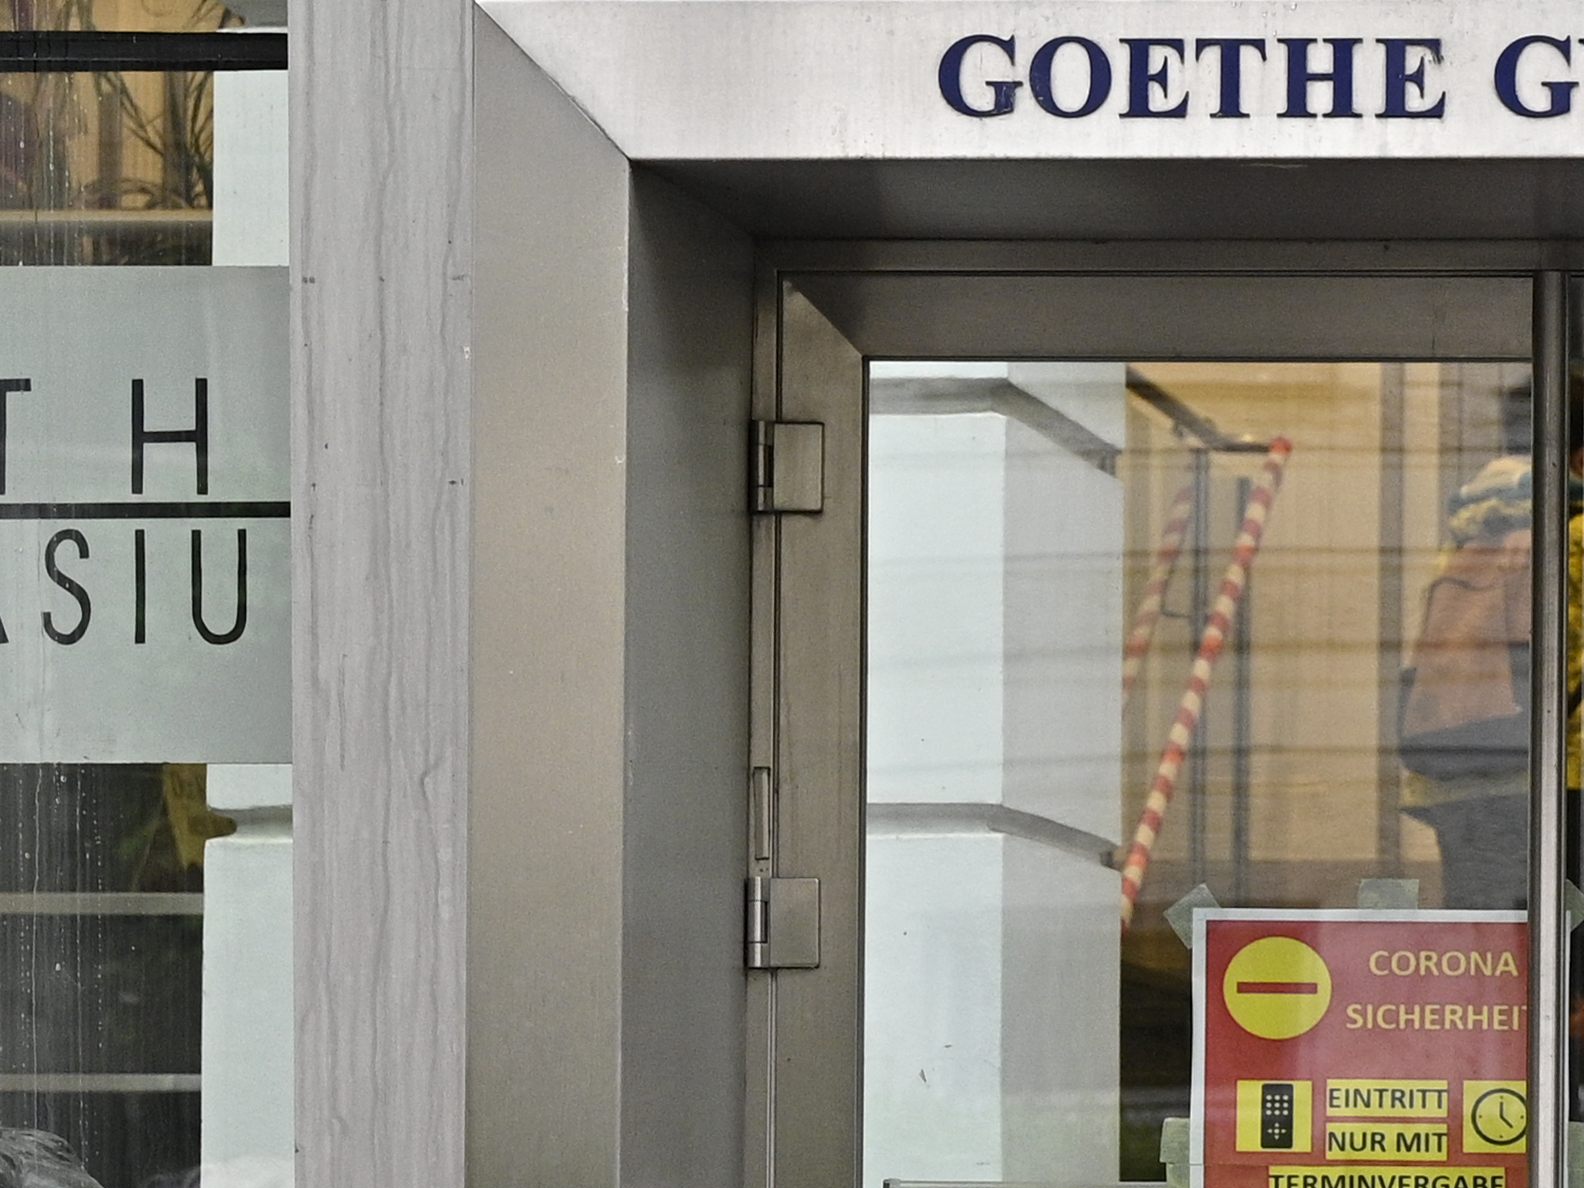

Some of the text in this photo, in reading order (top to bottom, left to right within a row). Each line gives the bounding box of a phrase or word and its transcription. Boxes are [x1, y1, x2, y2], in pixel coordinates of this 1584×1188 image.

[937, 34, 1447, 119] GOETHE
[0, 529, 247, 645] SIU
[1369, 950, 1518, 977] CORONA
[1346, 1004, 1527, 1031] SICHERHEI
[1329, 1088, 1448, 1110] EINTRITT
[1328, 1131, 1448, 1154] NUR MIT
